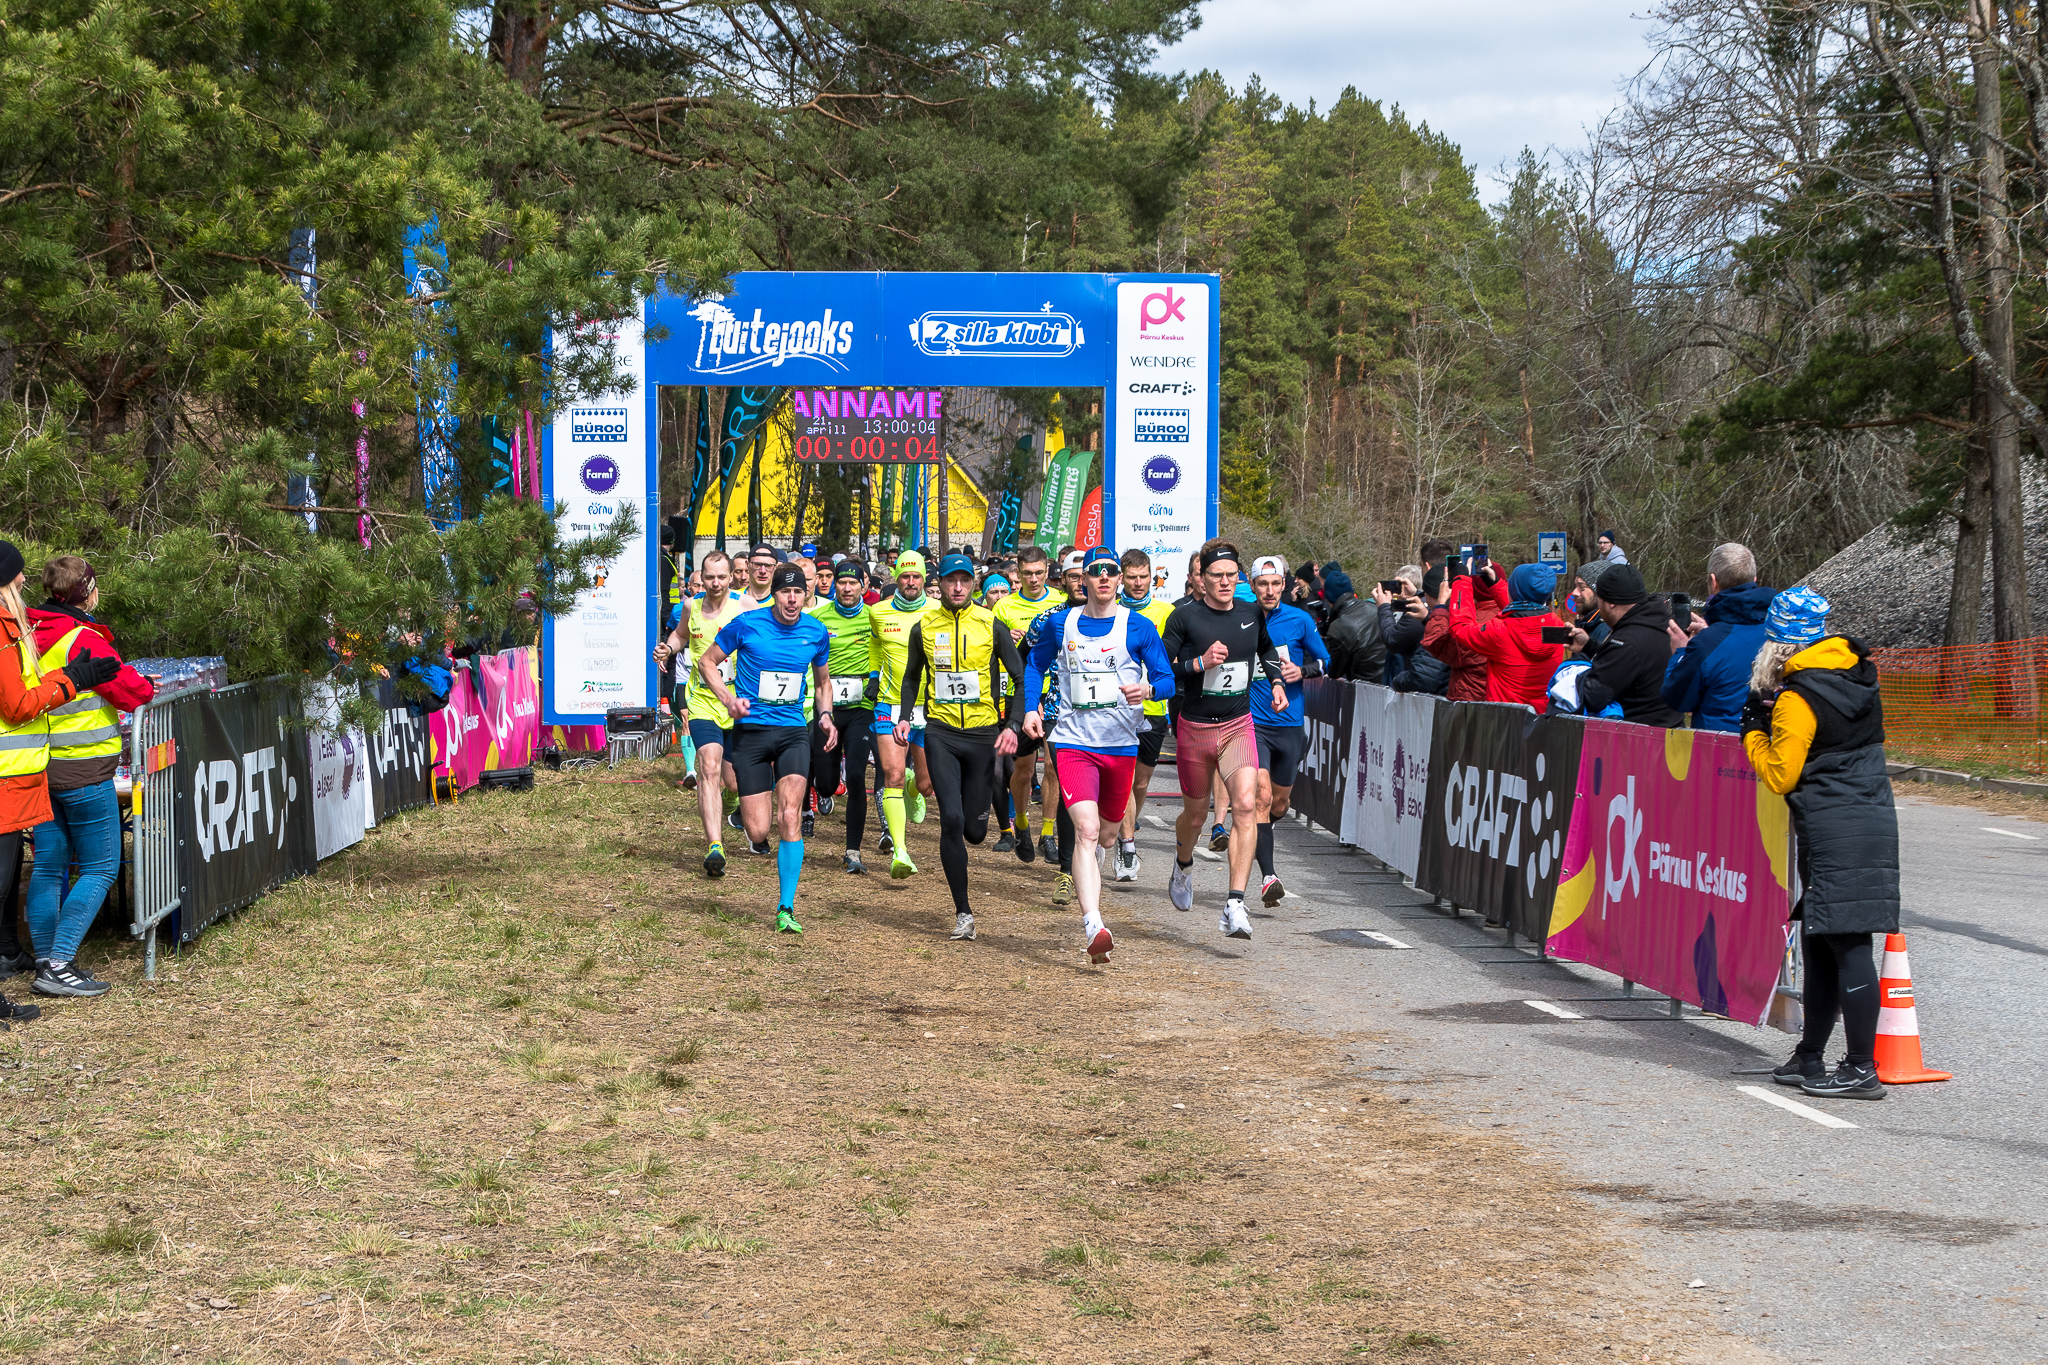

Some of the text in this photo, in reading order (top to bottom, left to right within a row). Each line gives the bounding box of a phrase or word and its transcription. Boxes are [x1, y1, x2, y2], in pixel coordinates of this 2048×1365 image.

[932, 320, 1062, 345] 2 silla klubi
[1130, 355, 1196, 368] WENDRE
[1129, 383, 1182, 394] CRAFT
[813, 416, 832, 426] 21.
[863, 420, 936, 434] 13:00:04
[574, 422, 624, 433] BÜROO
[806, 424, 846, 435] aprill
[1137, 422, 1187, 433] BÜROO
[796, 436, 940, 460] 00:00:04
[586, 467, 614, 479] Farmi
[1147, 467, 1175, 479] Farmi
[1084, 503, 1101, 547] GasUp
[582, 612, 618, 620] ESTONIA
[1223, 675, 1233, 688] 2
[778, 684, 787, 697] 7
[840, 688, 849, 698] 4
[947, 683, 967, 695] 13
[1088, 685, 1096, 700] 1
[1445, 760, 1528, 868] CRAFT
[1649, 840, 1748, 903] Pärnu Keskus
